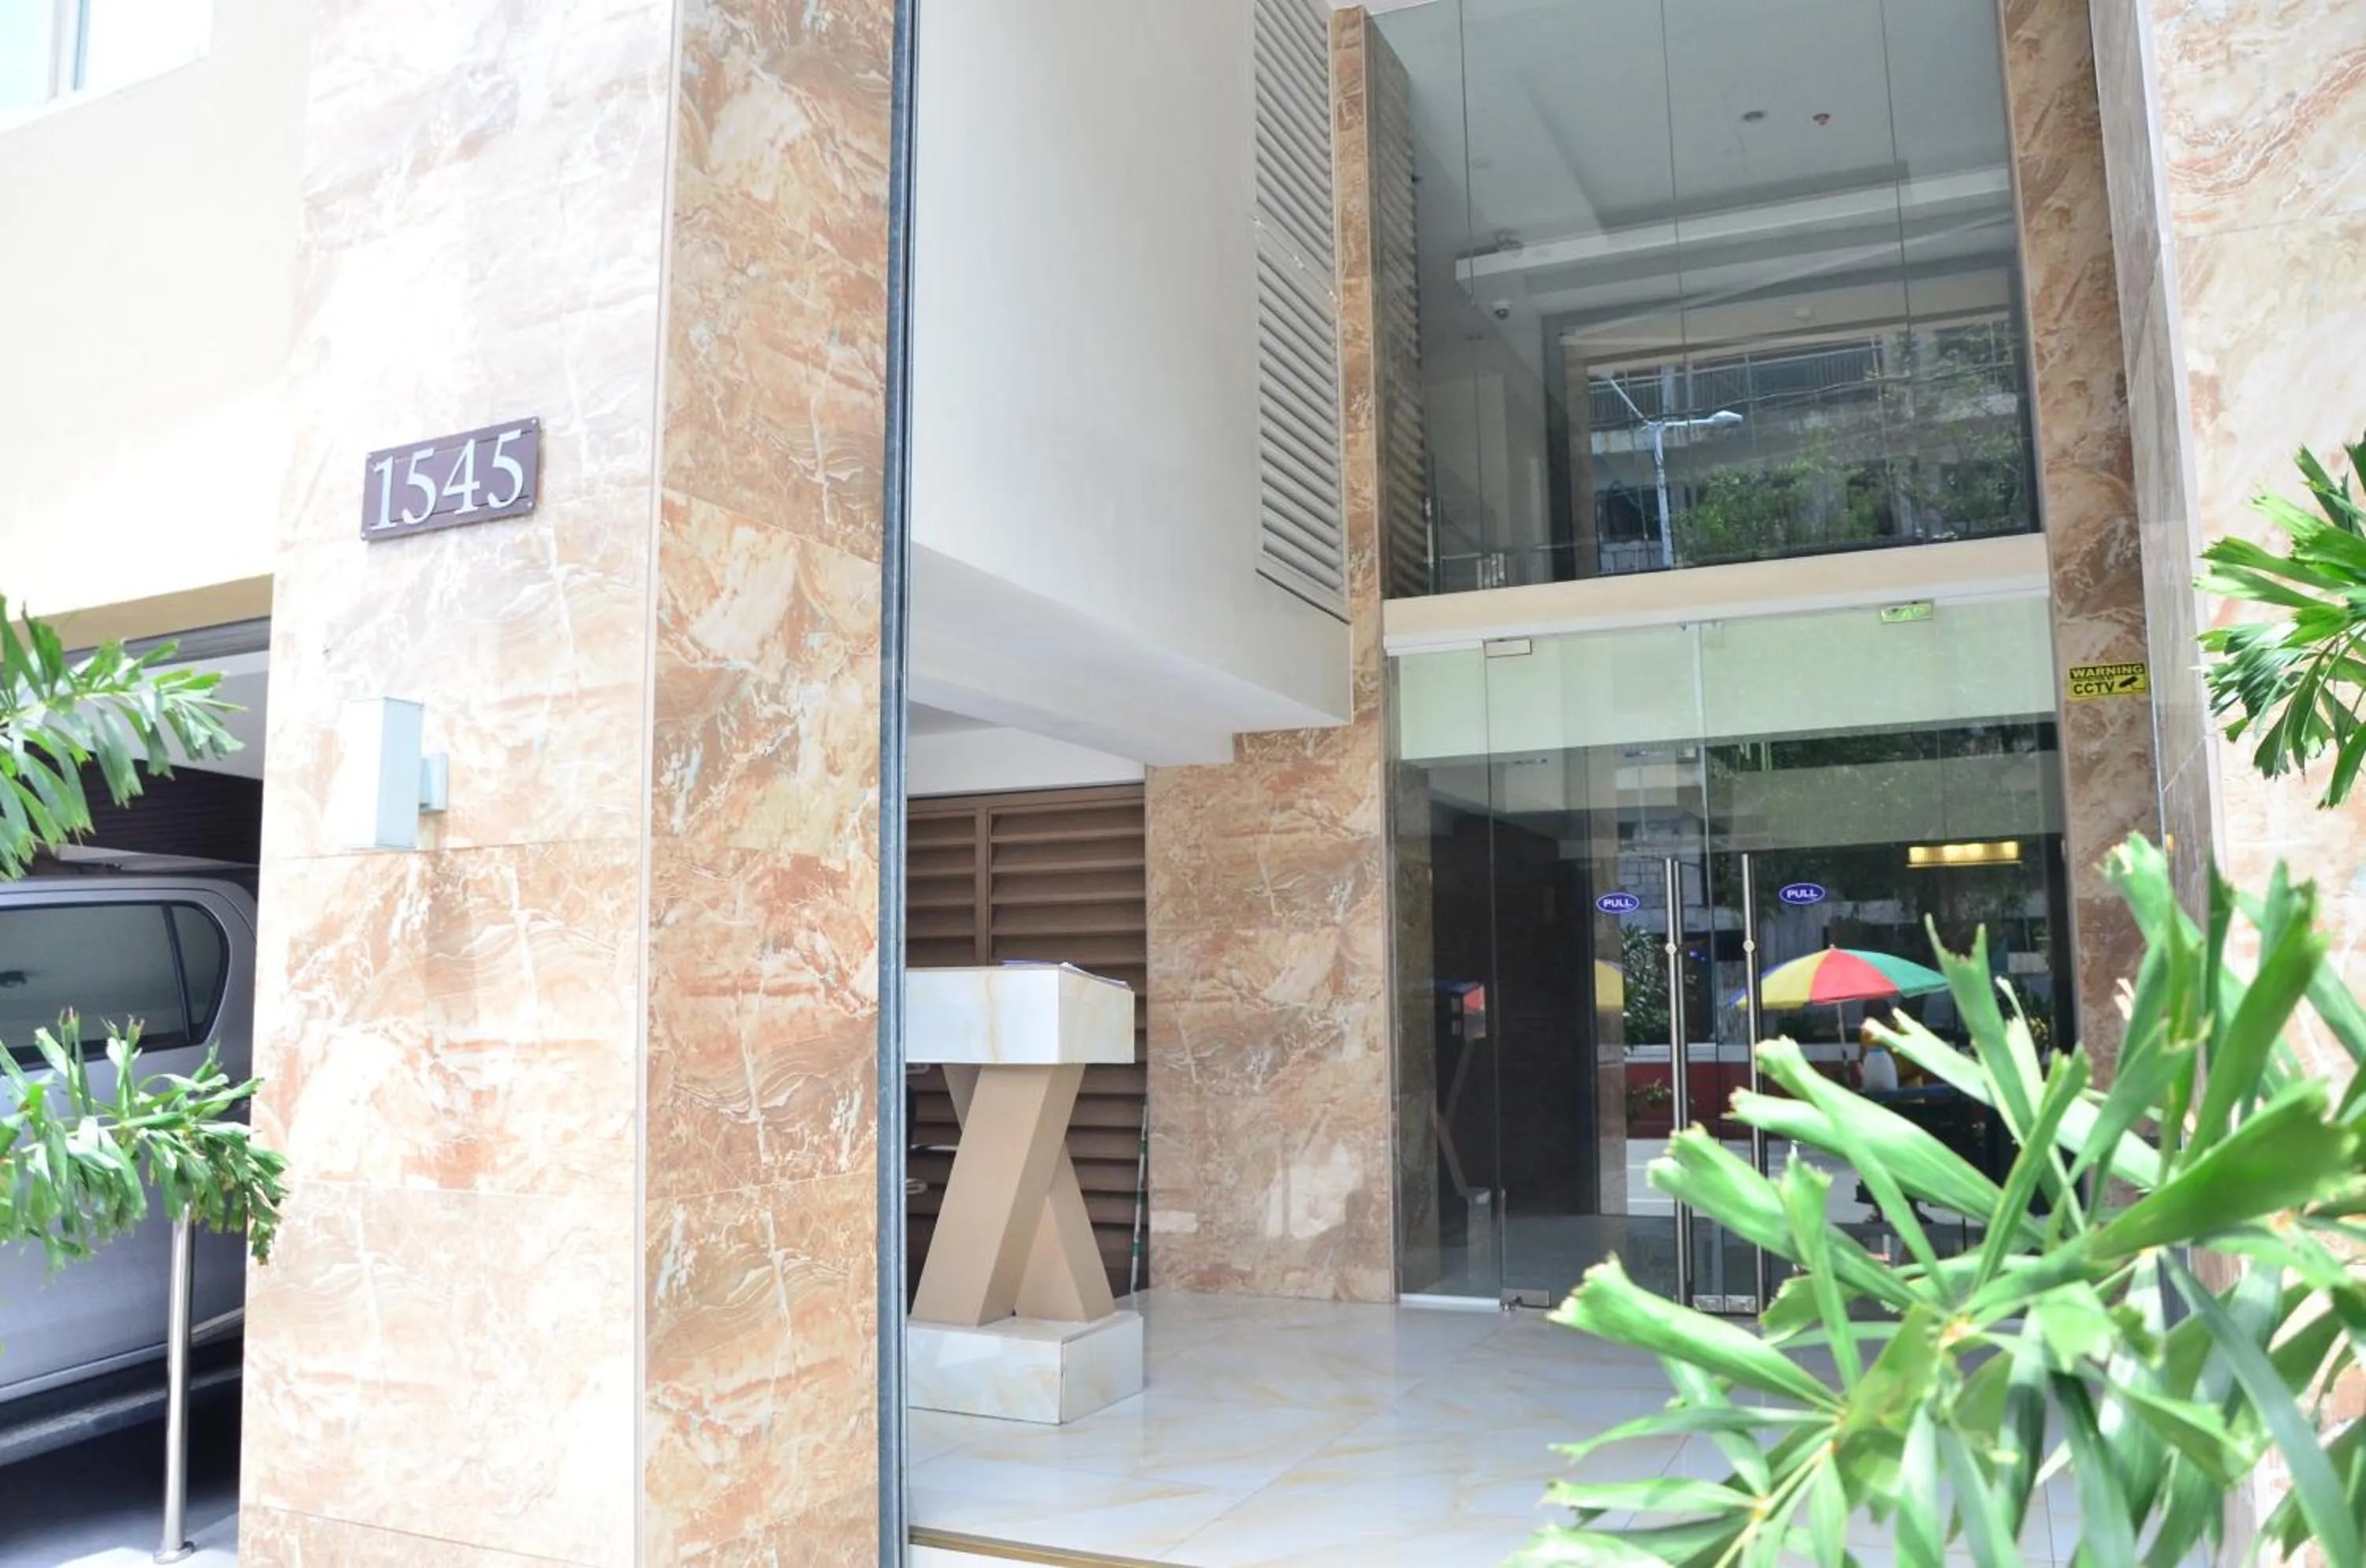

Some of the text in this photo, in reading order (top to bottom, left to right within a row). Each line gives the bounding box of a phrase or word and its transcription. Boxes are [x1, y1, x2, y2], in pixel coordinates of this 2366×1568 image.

[369, 428, 524, 530] 1545
[2071, 665, 2144, 678] WARNING
[2073, 681, 2115, 694] CCTV
[1786, 889, 1819, 898] PULL
[1603, 898, 1633, 908] PULL
